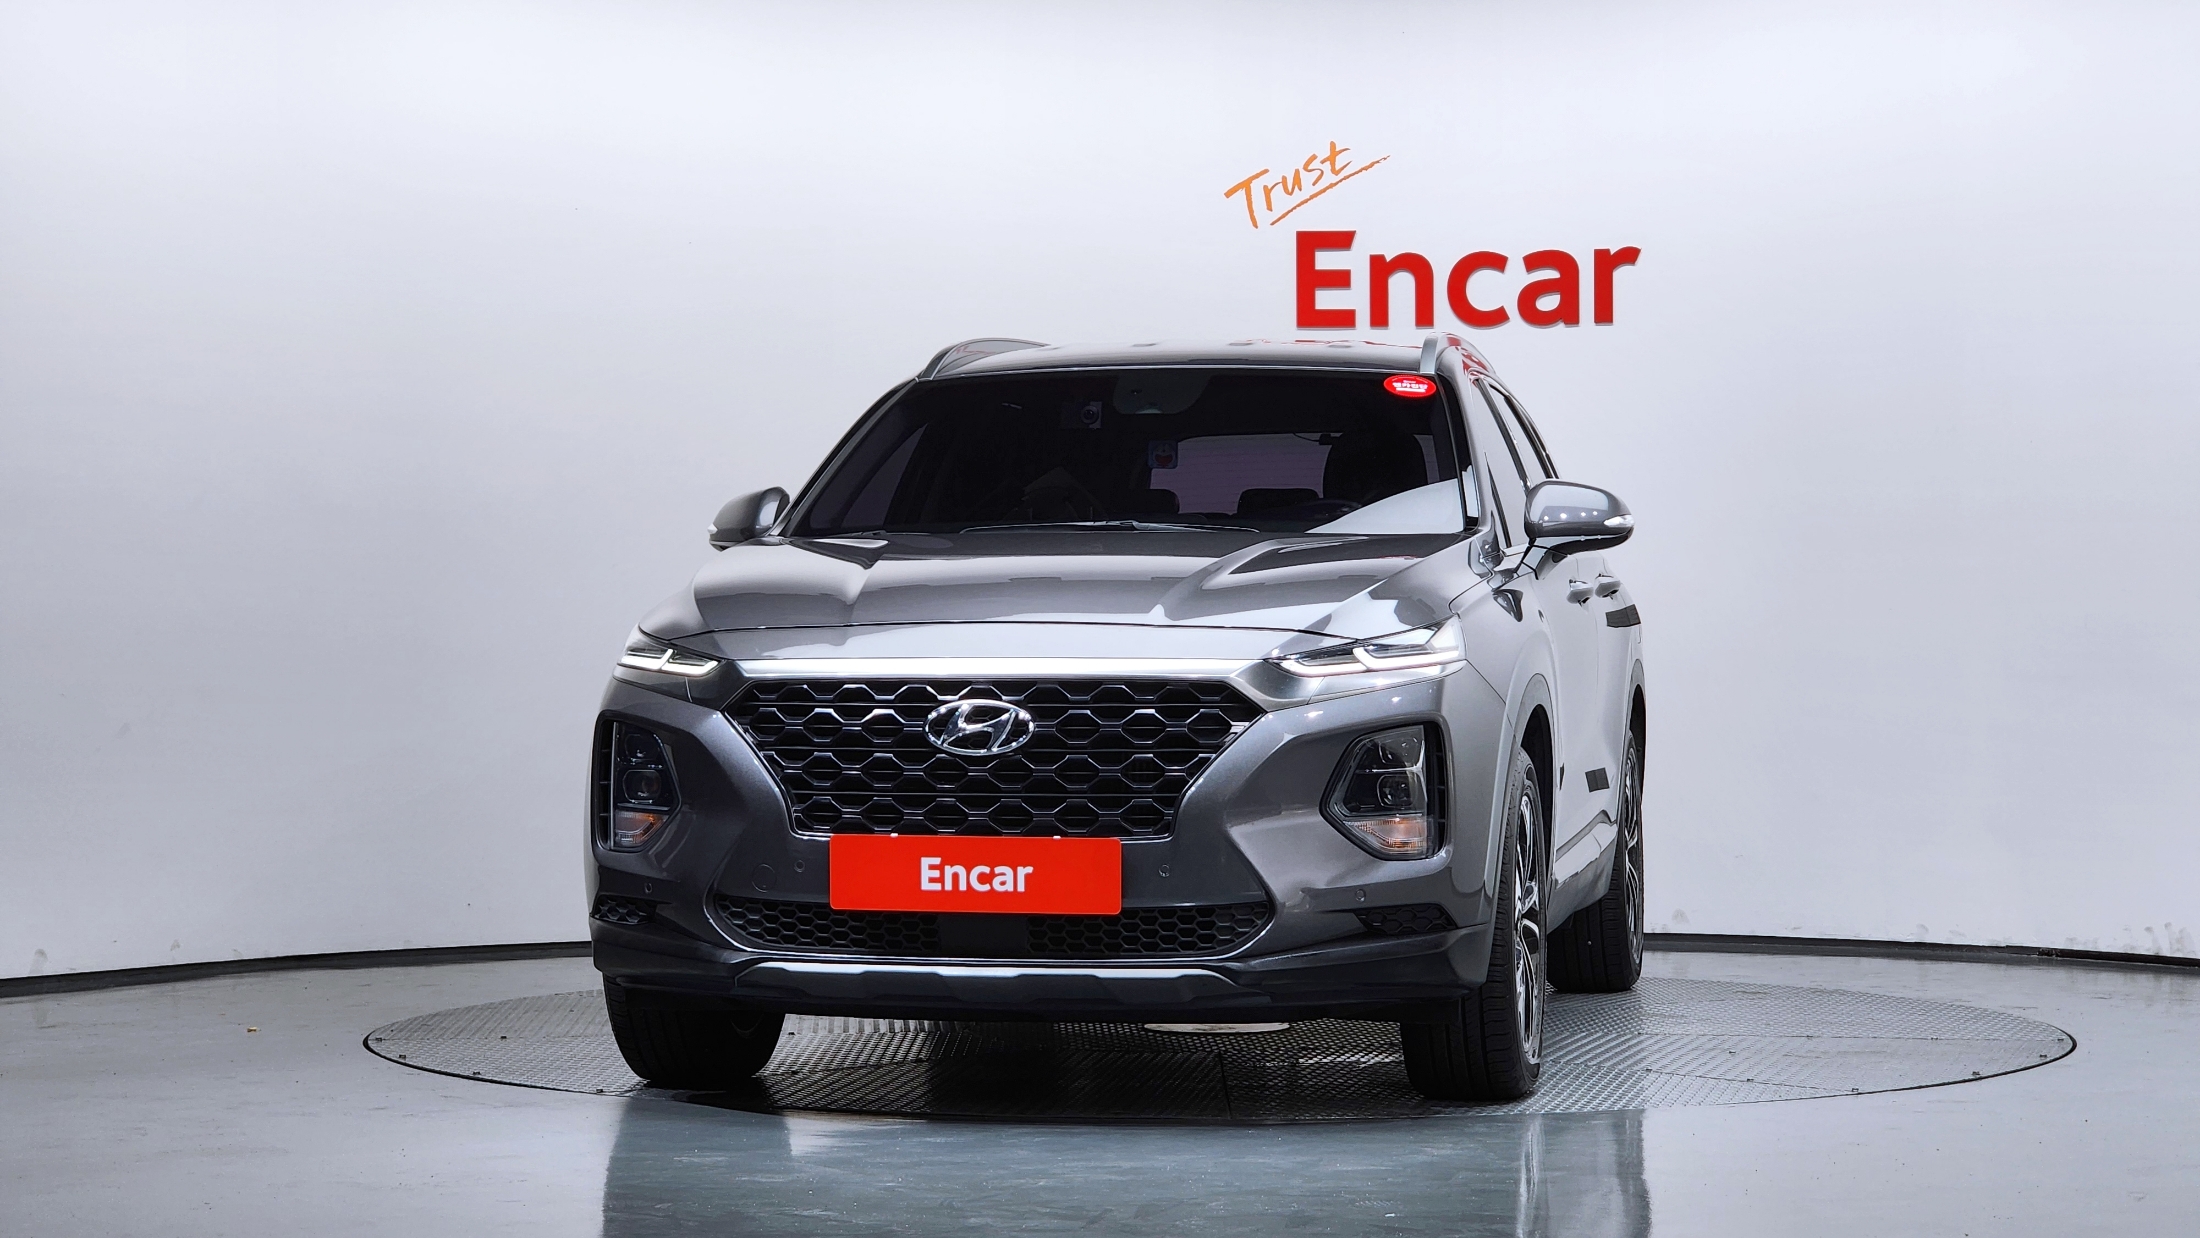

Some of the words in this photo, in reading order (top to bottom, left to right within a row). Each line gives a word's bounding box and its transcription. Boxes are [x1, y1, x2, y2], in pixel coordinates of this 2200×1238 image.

[1224, 141, 1351, 229] Trust
[1296, 230, 1641, 329] Encar
[920, 856, 1034, 892] Encar
